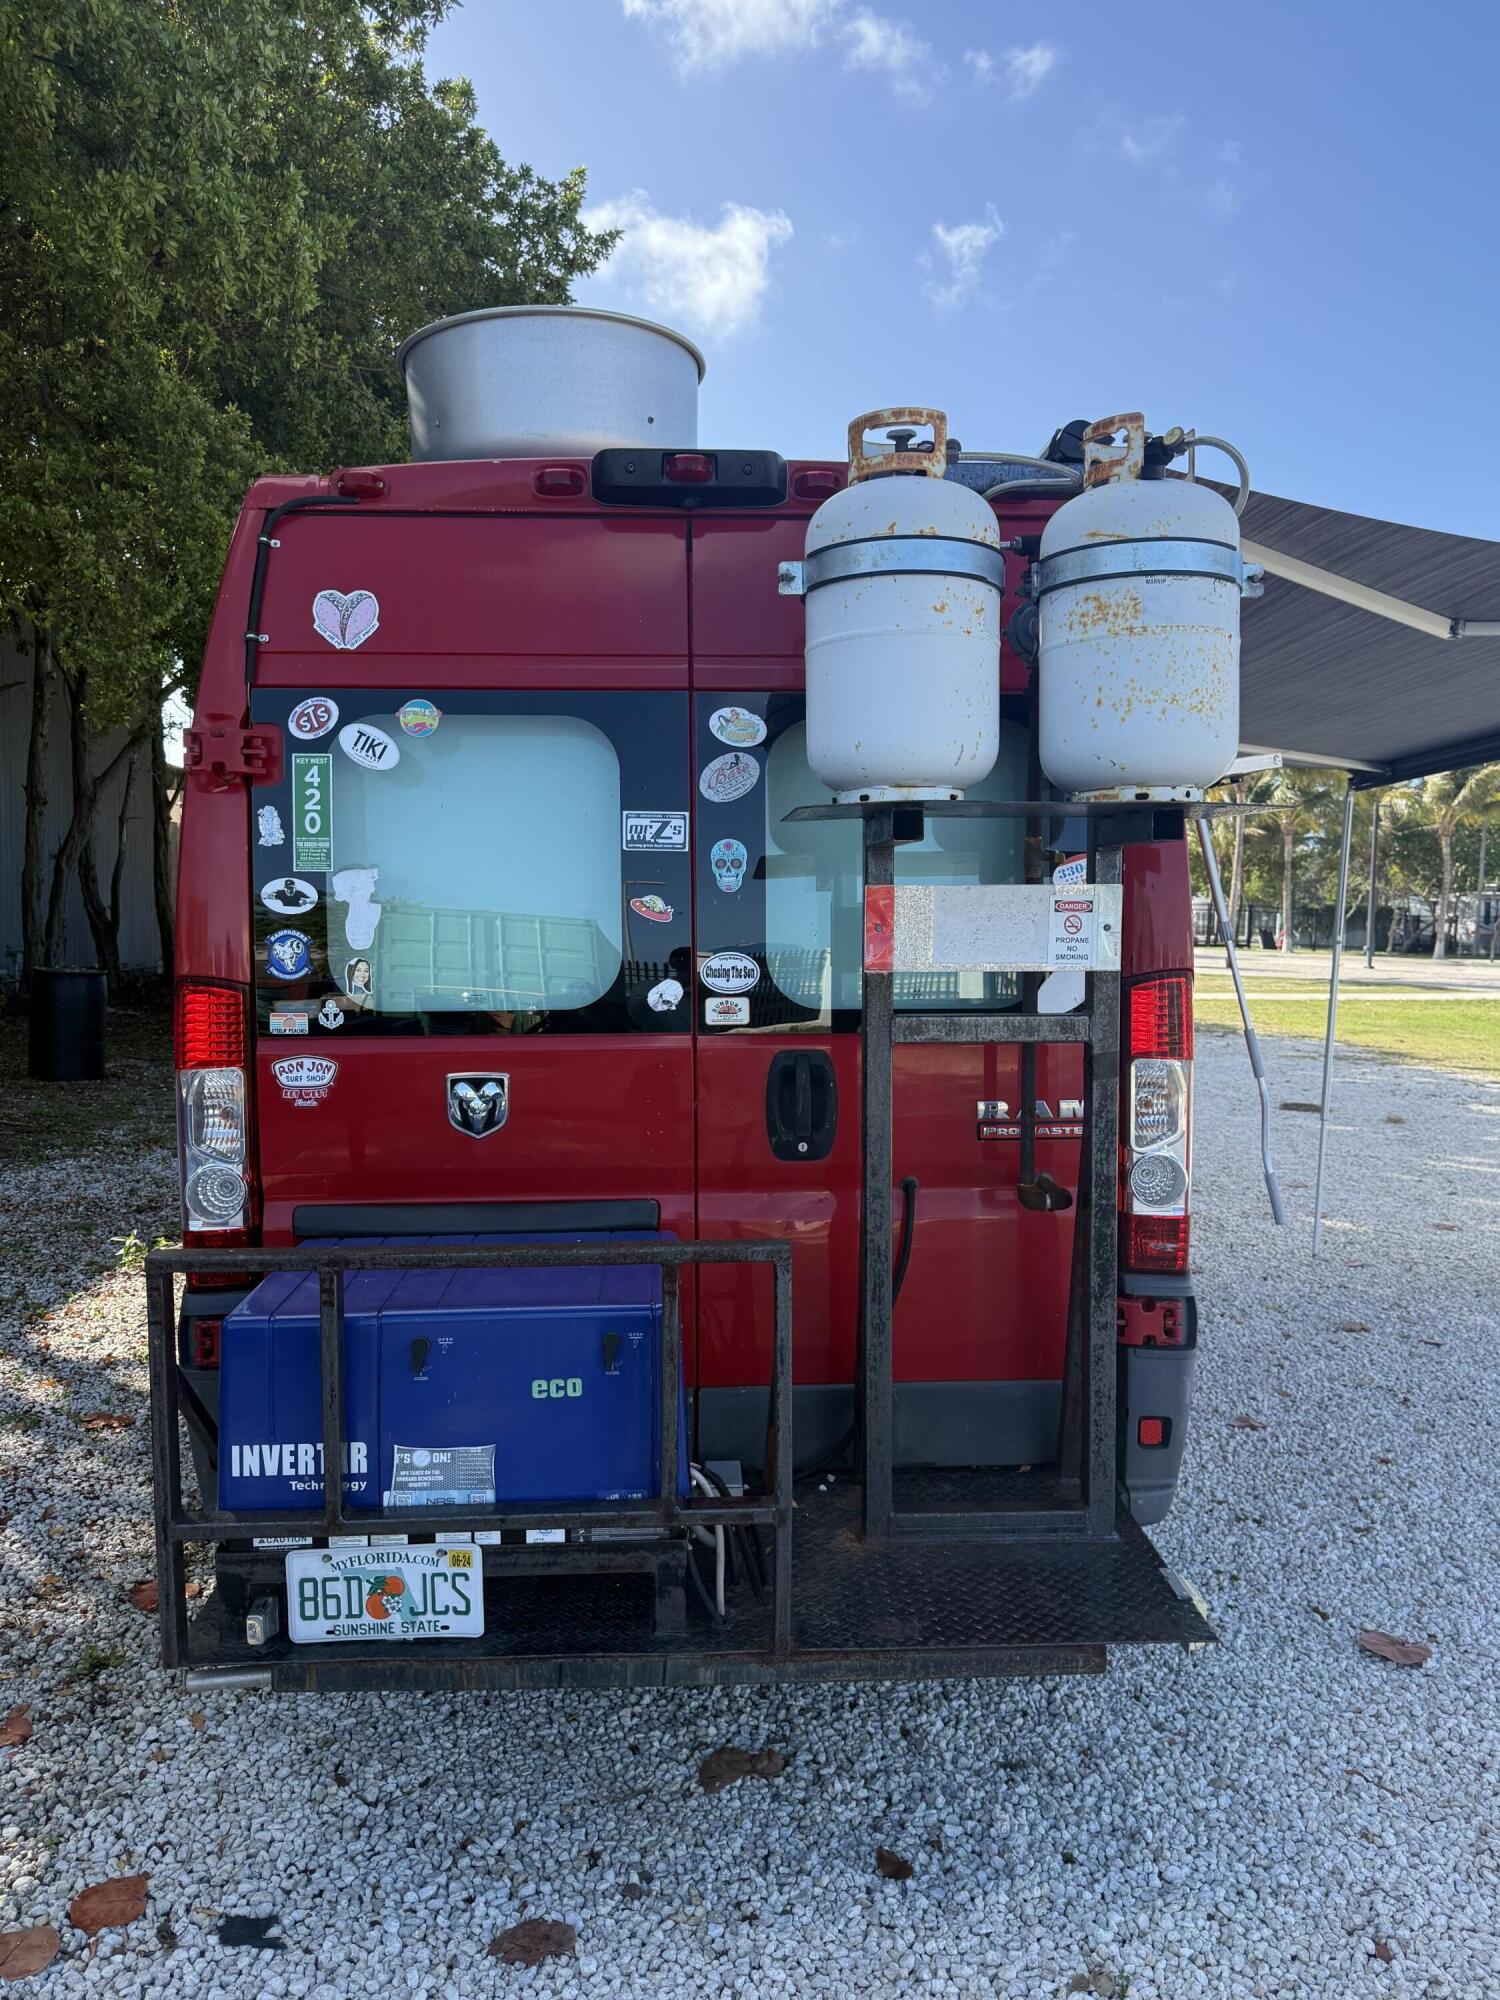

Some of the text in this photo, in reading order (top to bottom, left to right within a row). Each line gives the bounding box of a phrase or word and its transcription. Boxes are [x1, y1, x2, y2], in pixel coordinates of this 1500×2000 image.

[299, 706, 329, 731] STS
[353, 729, 389, 761] TIKI
[310, 757, 328, 765] WEST
[304, 765, 321, 834] 420
[1058, 864, 1084, 880] 330
[270, 930, 308, 941] RAMPAGERS
[706, 964, 755, 983] Chasing The Sun
[278, 1061, 332, 1076] RON JON
[282, 1089, 328, 1098] KEY WEST
[984, 1127, 1084, 1136] PROASTE
[532, 1378, 583, 1398] eco
[231, 1442, 368, 1477] INVERTR
[432, 1453, 451, 1464] ON!
[266, 1536, 307, 1544] CAUTION
[331, 1551, 440, 1572] MYFLORIDA.COM
[451, 1554, 471, 1567] 06-24
[298, 1572, 471, 1621] 86D JCS
[334, 1620, 441, 1636] SUNSHINE STATE
